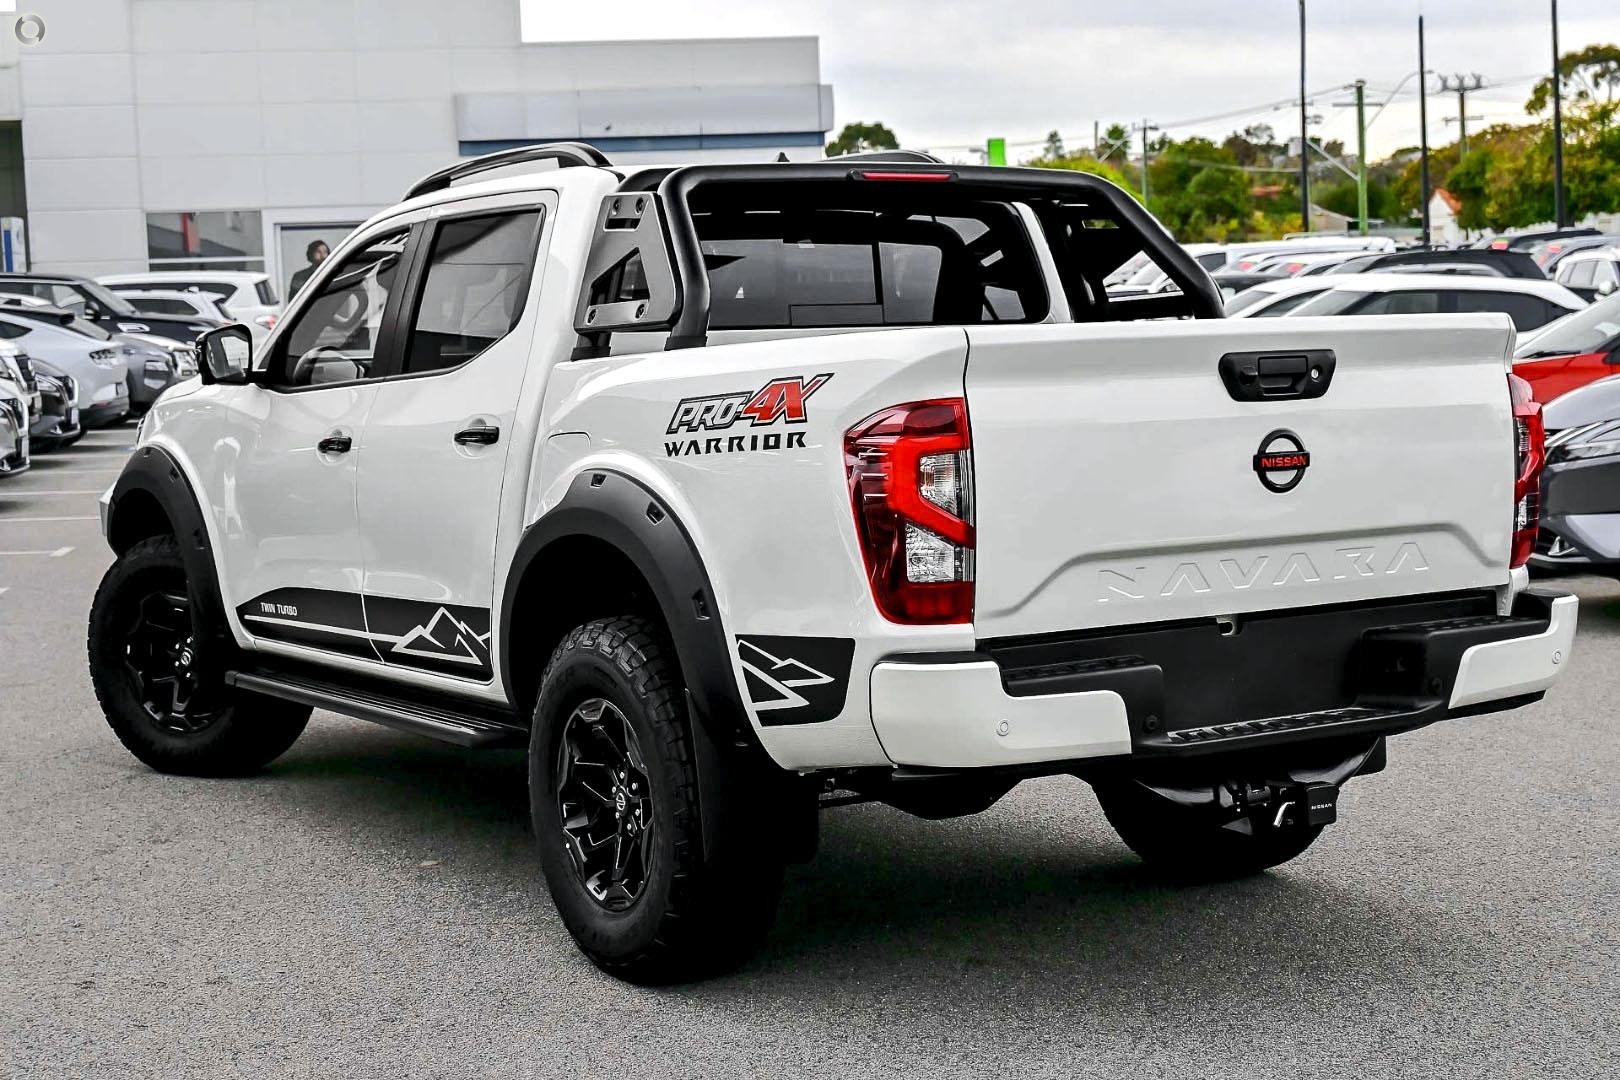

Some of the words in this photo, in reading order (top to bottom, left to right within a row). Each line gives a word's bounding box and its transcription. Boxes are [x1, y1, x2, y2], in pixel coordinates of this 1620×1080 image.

[666, 373, 835, 435] PRO-4X
[664, 432, 807, 457] WARRIOR
[1261, 455, 1307, 468] NISSAN
[1098, 542, 1429, 603] NAVARA
[260, 602, 276, 614] TWIN
[276, 604, 298, 616] TURBO
